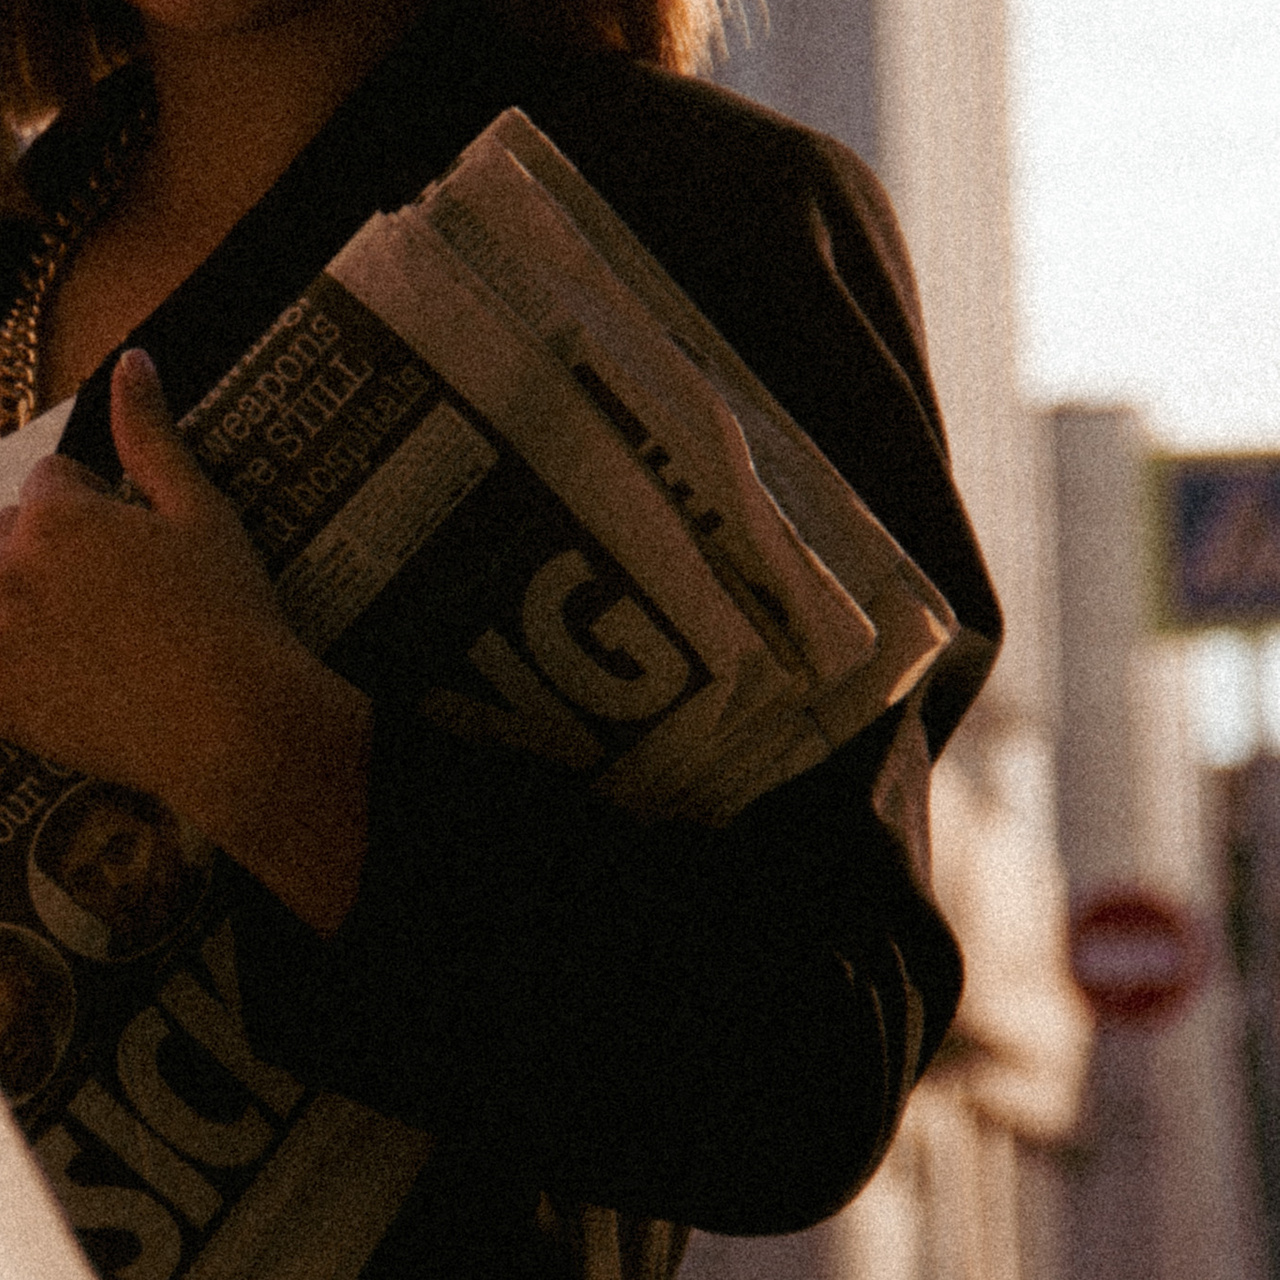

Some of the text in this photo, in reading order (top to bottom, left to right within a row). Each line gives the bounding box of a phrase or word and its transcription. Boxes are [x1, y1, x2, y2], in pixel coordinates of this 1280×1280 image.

[198, 313, 341, 462] weapons
[227, 457, 278, 508] re
[266, 352, 374, 459] STILL
[283, 365, 431, 517] hospitals
